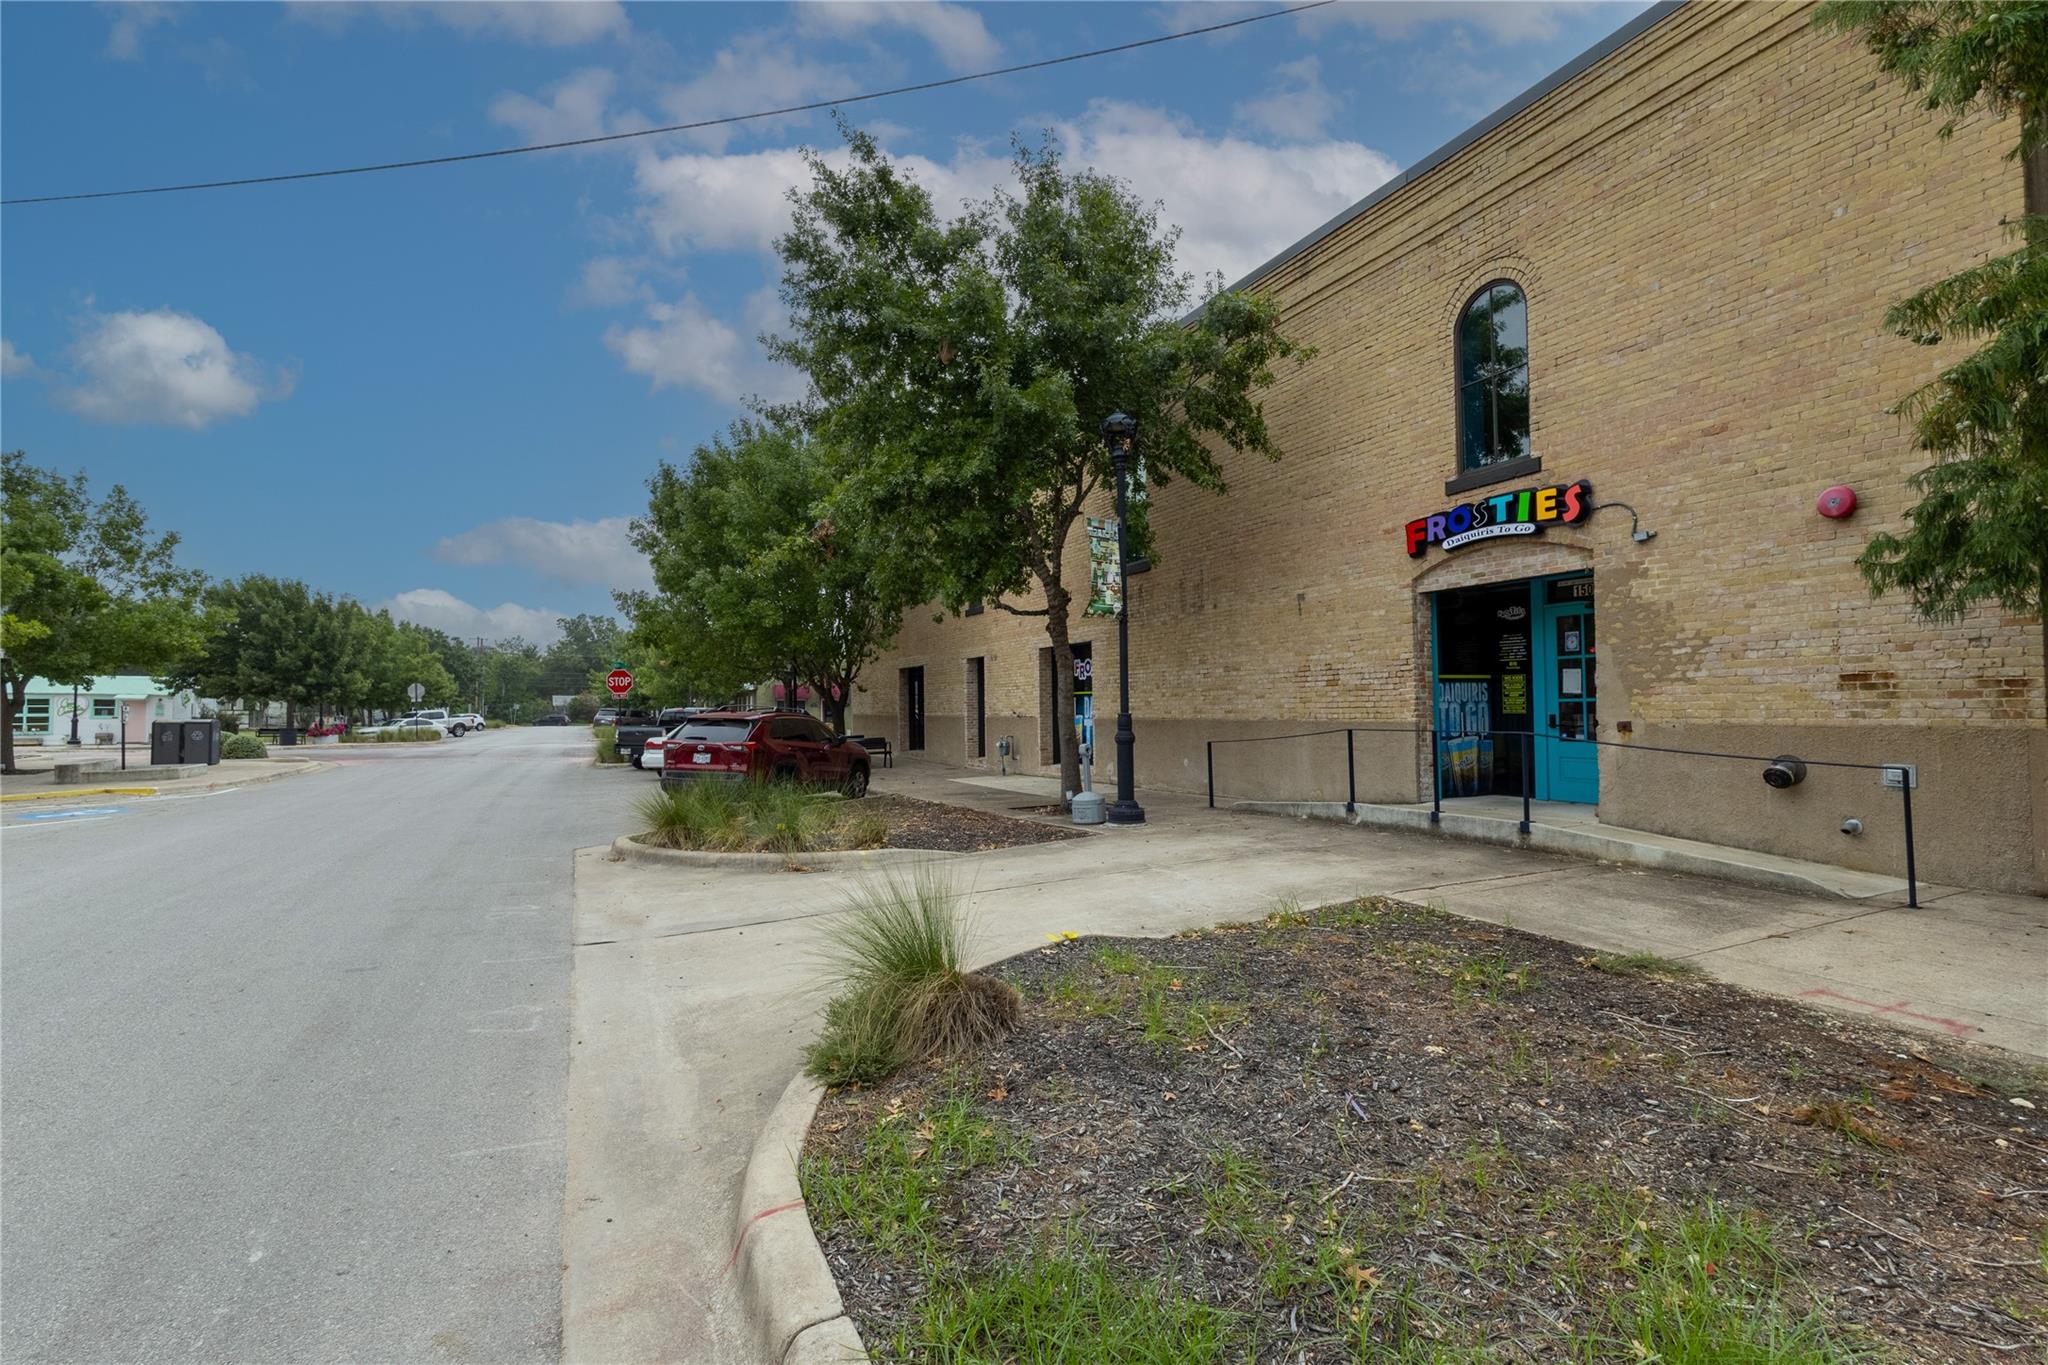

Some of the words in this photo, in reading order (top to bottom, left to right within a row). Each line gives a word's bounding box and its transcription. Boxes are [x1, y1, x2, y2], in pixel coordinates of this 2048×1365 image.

[1406, 484, 1582, 554] FROSTIES
[1446, 527, 1495, 547] Daiquiris
[1497, 525, 1511, 534] To
[1514, 523, 1532, 533] Go
[1074, 658, 1092, 680] FRO
[608, 677, 631, 687] STOP
[1439, 702, 1461, 737] TO
[1465, 701, 1490, 737] GO
